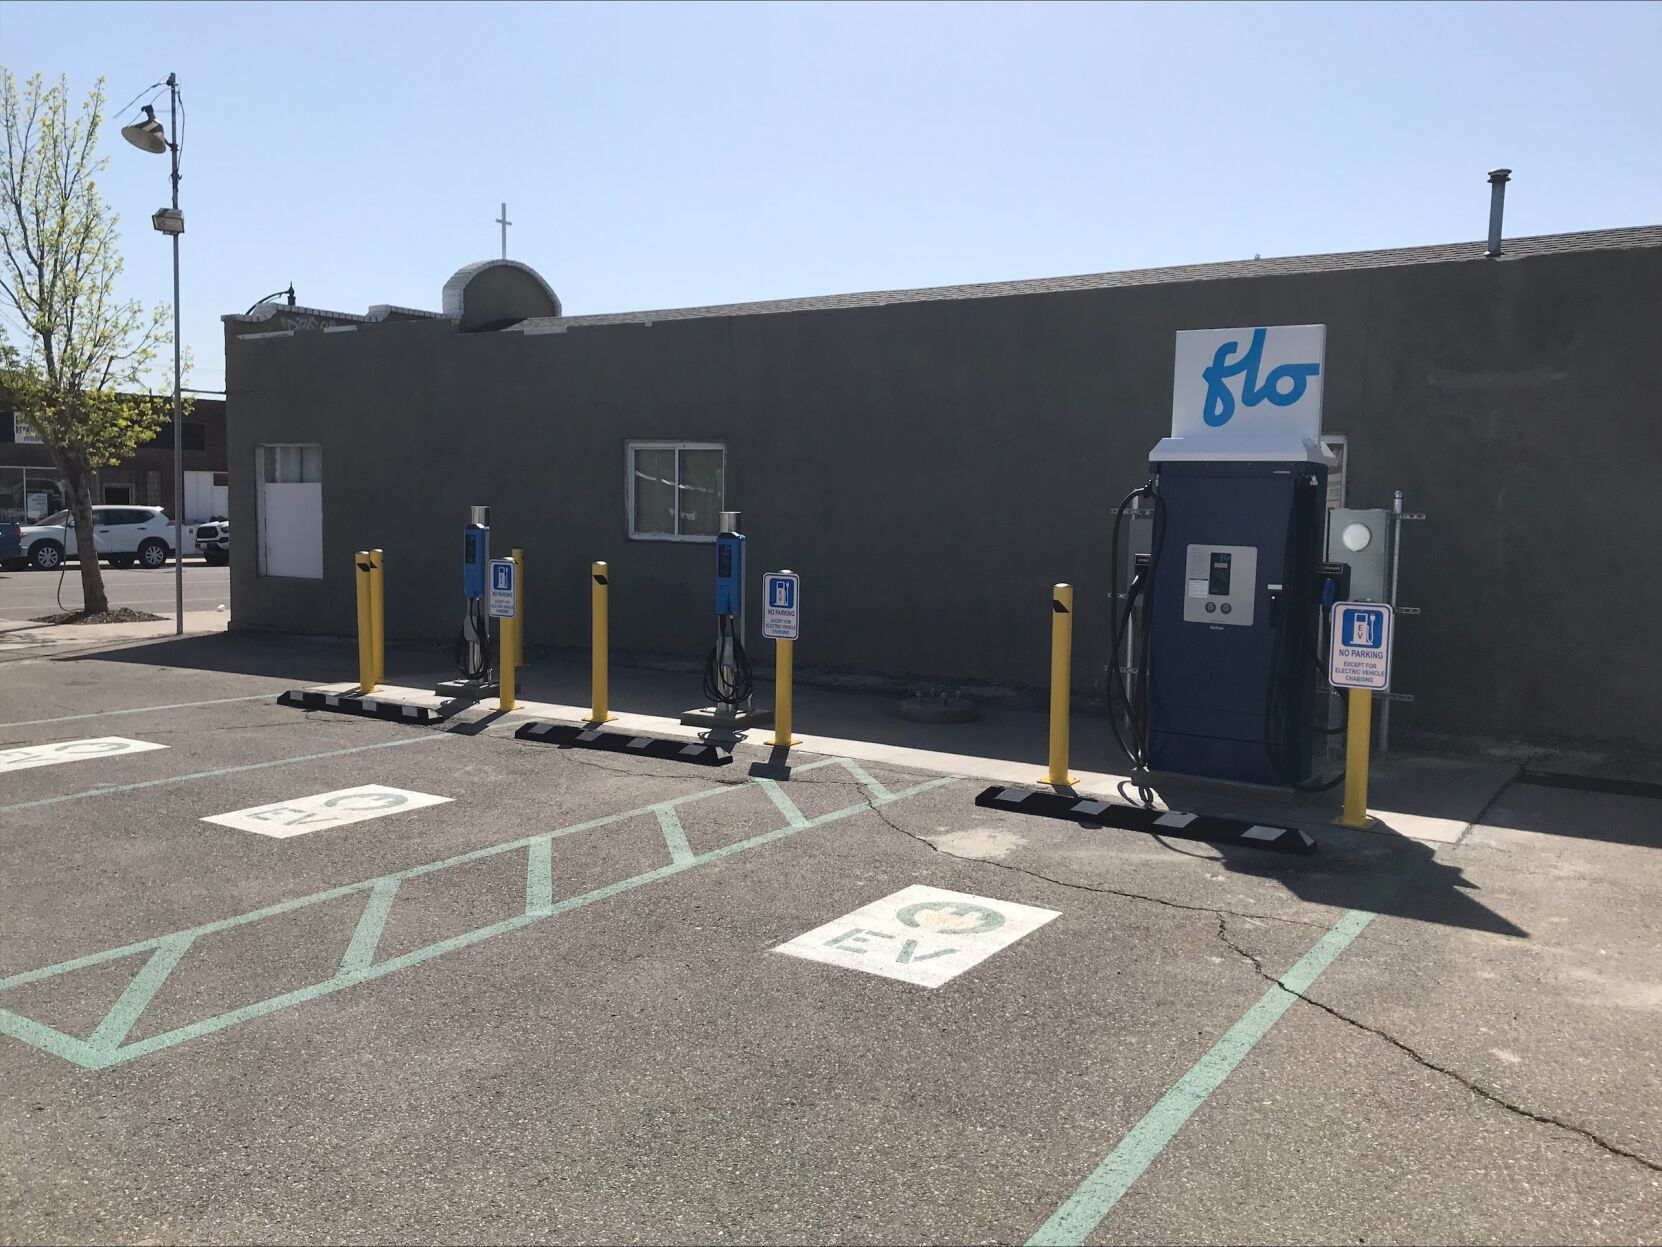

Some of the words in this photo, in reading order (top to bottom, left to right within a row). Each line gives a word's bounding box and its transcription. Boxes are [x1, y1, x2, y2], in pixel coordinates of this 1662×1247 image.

[775, 609, 795, 617] PARKING
[1339, 649, 1350, 657] NO
[1351, 650, 1384, 660] PARKING
[1335, 667, 1361, 675] ELECTRIC
[1362, 669, 1385, 677] VEHICLE
[1345, 675, 1374, 683] CHARGING
[823, 927, 962, 964] EV
